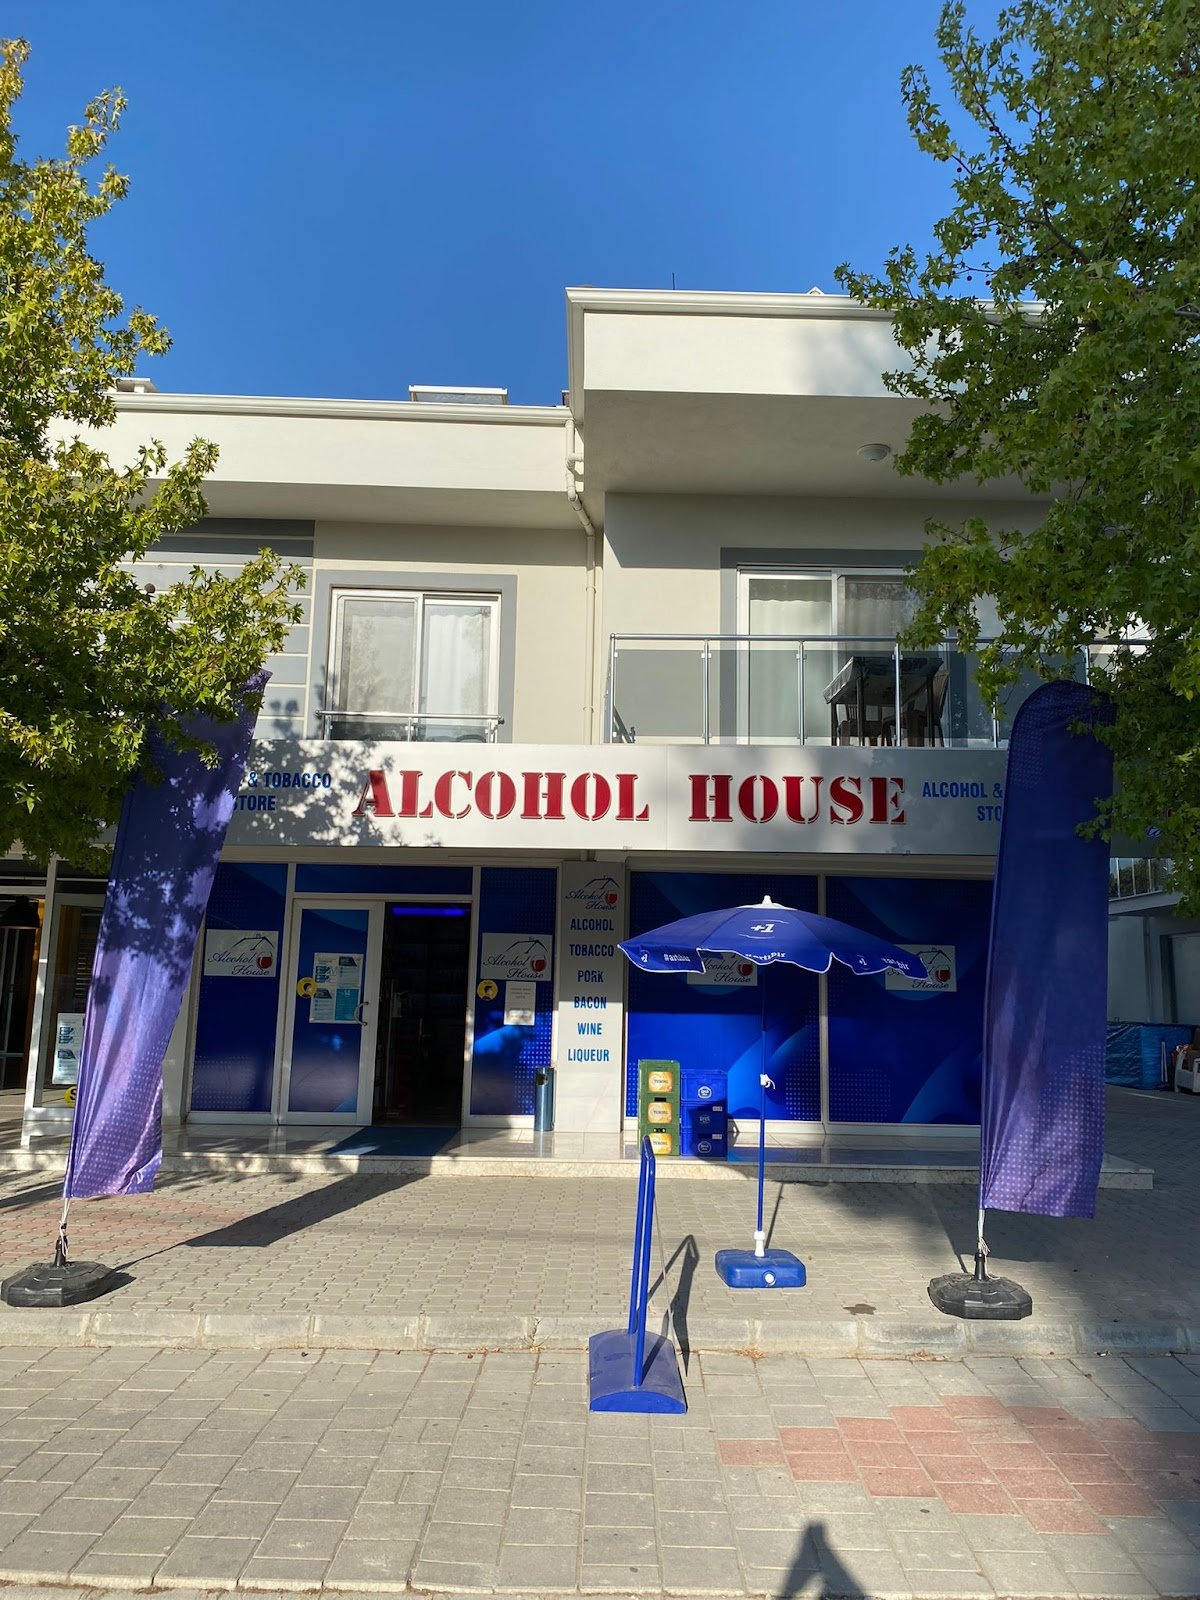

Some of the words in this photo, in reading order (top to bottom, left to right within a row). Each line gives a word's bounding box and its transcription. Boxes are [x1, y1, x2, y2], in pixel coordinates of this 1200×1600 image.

[247, 771, 258, 788] &
[263, 771, 332, 789] TOBACCO
[922, 781, 988, 799] ALCOHOL
[992, 782, 1003, 799] &
[351, 769, 650, 822] ALCOHOL
[687, 774, 907, 825] HOUSE
[565, 888, 606, 901] Alcohol
[585, 901, 617, 910] House
[570, 918, 615, 931] ALCOHOL
[750, 923, 776, 934] +1
[569, 943, 615, 957] TOBACCO
[207, 950, 258, 964] Alcohol
[482, 953, 532, 967] Alcohol
[231, 964, 270, 976] House
[704, 958, 738, 972] lcohol
[506, 967, 544, 979] House
[577, 969, 604, 983] PORK
[714, 971, 751, 983] House
[911, 979, 949, 989] House
[573, 996, 607, 1009] BACON
[577, 1022, 603, 1035] WINE
[567, 1048, 610, 1063] LIQUEUR
